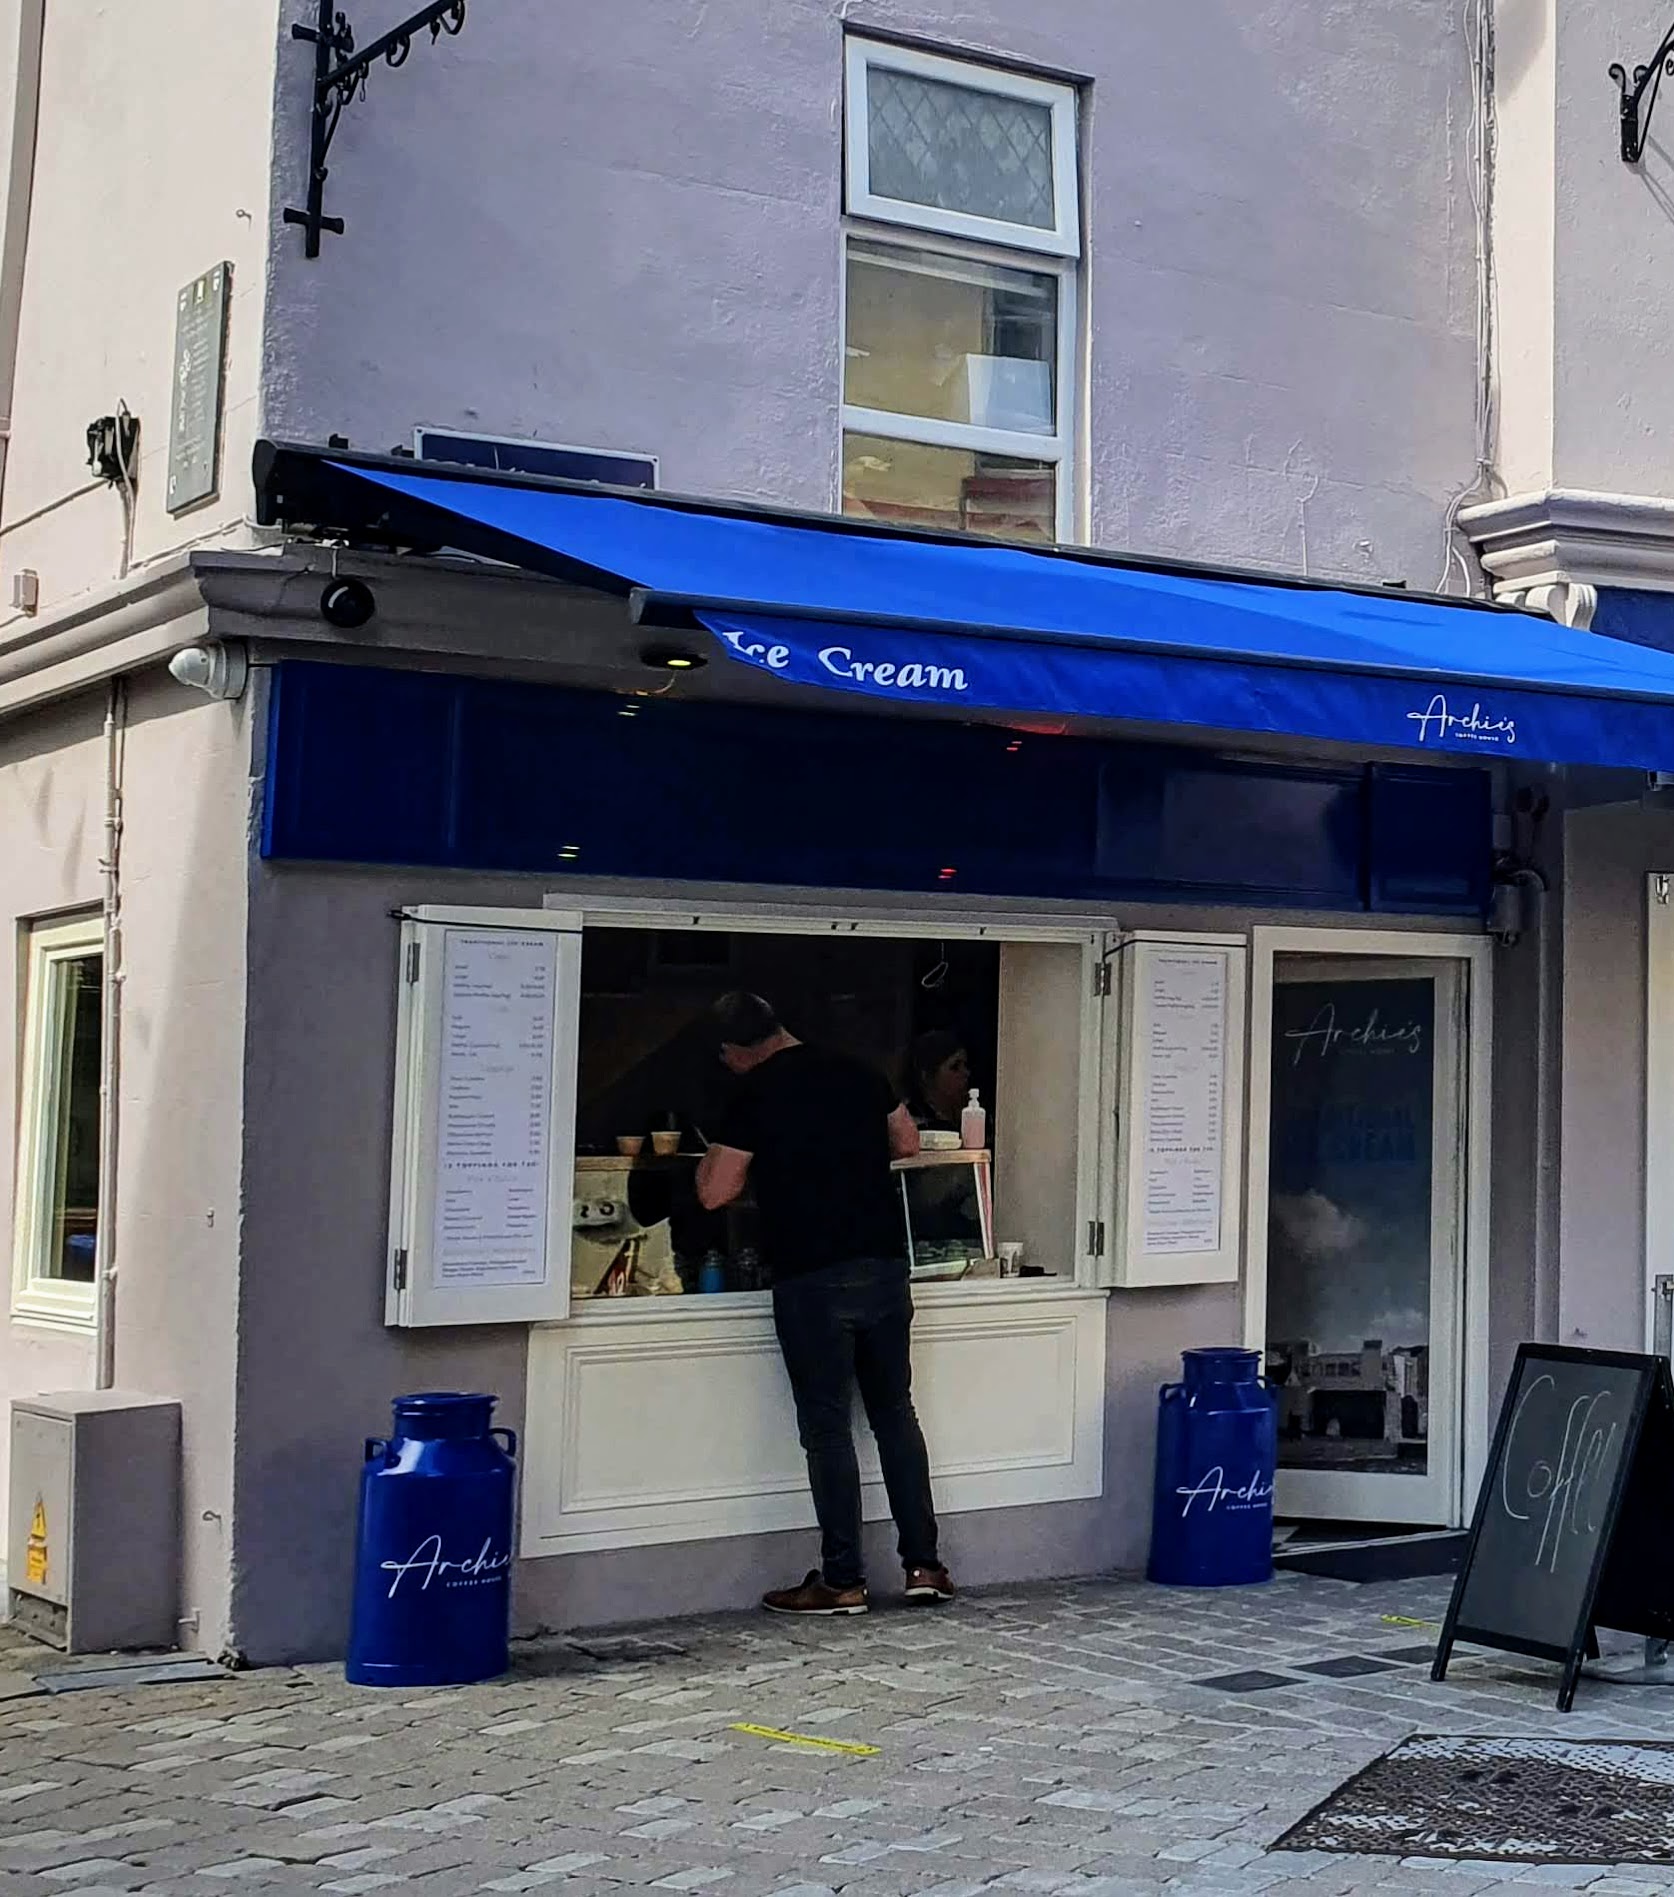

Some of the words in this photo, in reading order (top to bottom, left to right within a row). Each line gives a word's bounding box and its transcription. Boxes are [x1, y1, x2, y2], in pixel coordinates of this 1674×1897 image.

[817, 646, 969, 691] Cream
[1406, 694, 1516, 744] Archie's
[1176, 1466, 1273, 1518] Archi
[380, 1534, 511, 1599] Archi
